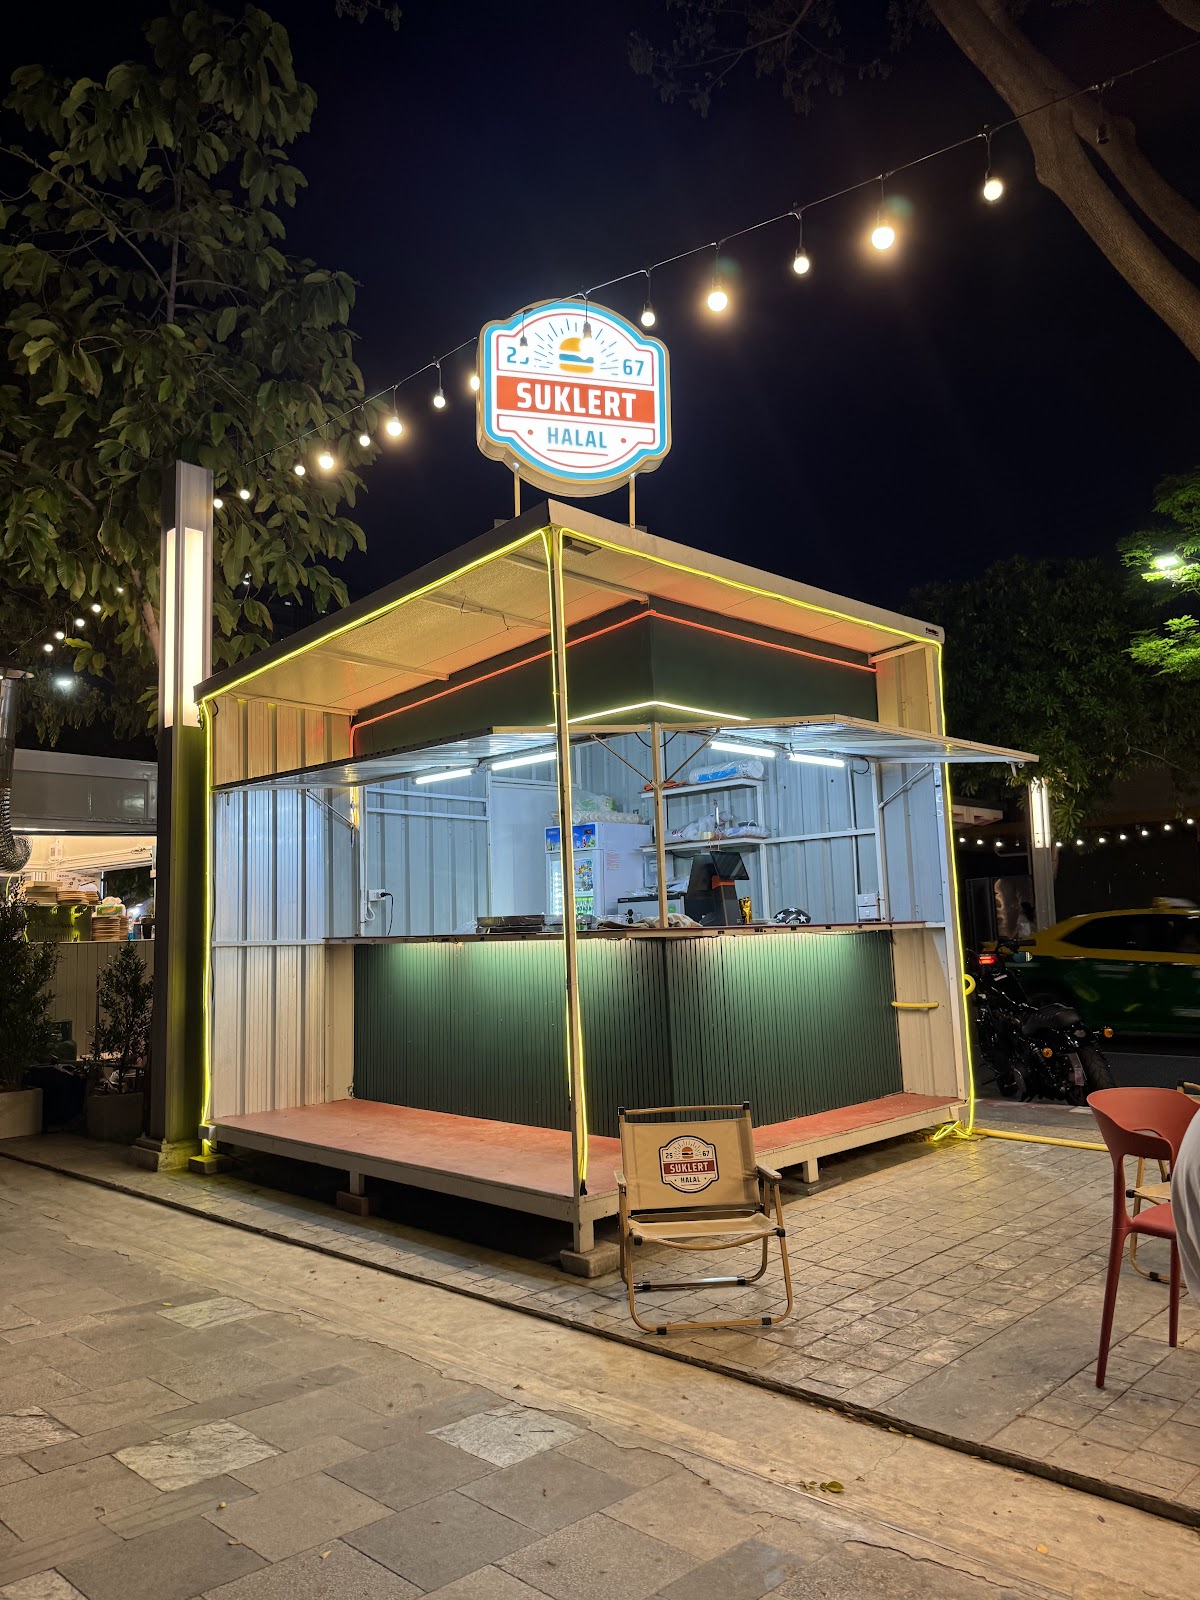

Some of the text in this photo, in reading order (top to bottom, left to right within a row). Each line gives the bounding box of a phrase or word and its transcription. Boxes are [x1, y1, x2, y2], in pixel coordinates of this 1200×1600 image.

[623, 358, 645, 376] 67
[516, 382, 637, 418] SUKLERT
[547, 426, 608, 449] HALAL
[670, 1162, 708, 1173] SUKLERT
